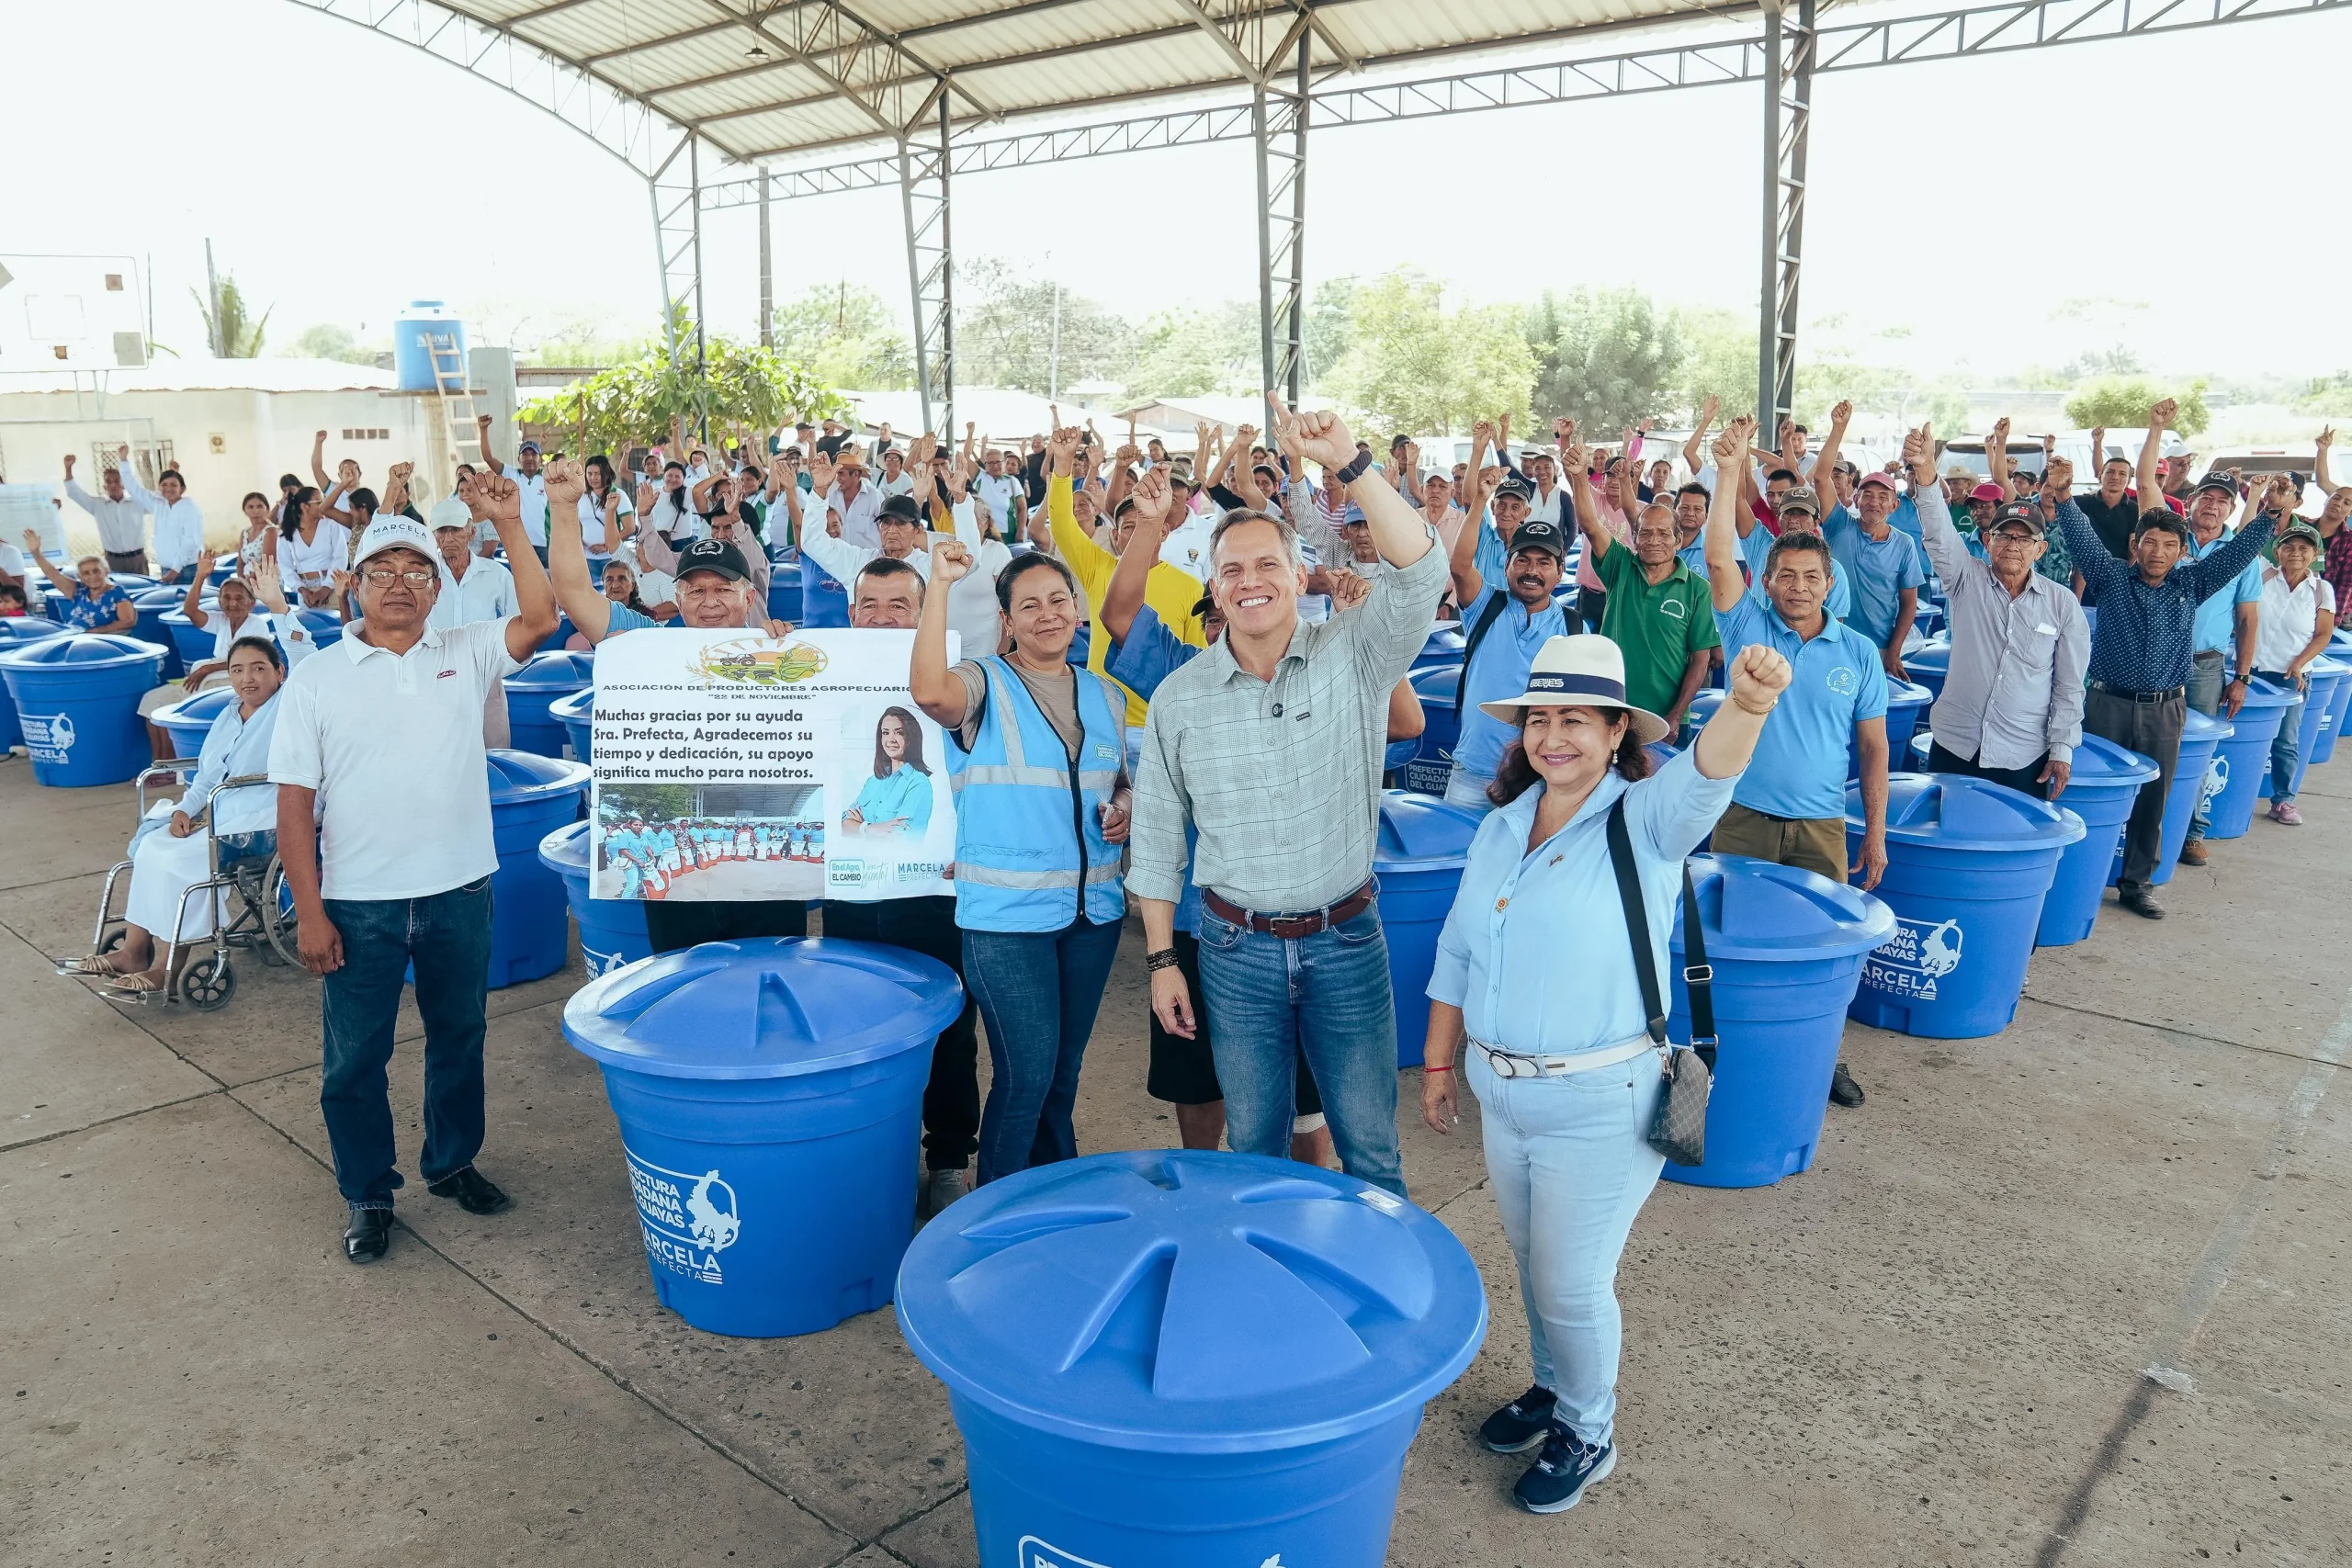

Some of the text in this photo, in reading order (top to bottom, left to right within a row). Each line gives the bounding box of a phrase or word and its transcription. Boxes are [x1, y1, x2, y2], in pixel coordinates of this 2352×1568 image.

[373, 524, 427, 538] MARCELA
[594, 709, 803, 723] Muchas gracias por su ayuda
[594, 728, 812, 742] Sra. Prefecta, Agradecemos su
[594, 747, 813, 761] tiempo y dedicación, su apoyo
[594, 765, 813, 780] significa mucho para nosotros.
[1408, 763, 1452, 776] PREFECTU
[1410, 780, 1424, 789] DEL
[898, 863, 945, 874] MARCELA
[906, 872, 938, 880] PREFECTA
[1862, 964, 1938, 992] ARCELA
[639, 1195, 684, 1229] GUAYAS
